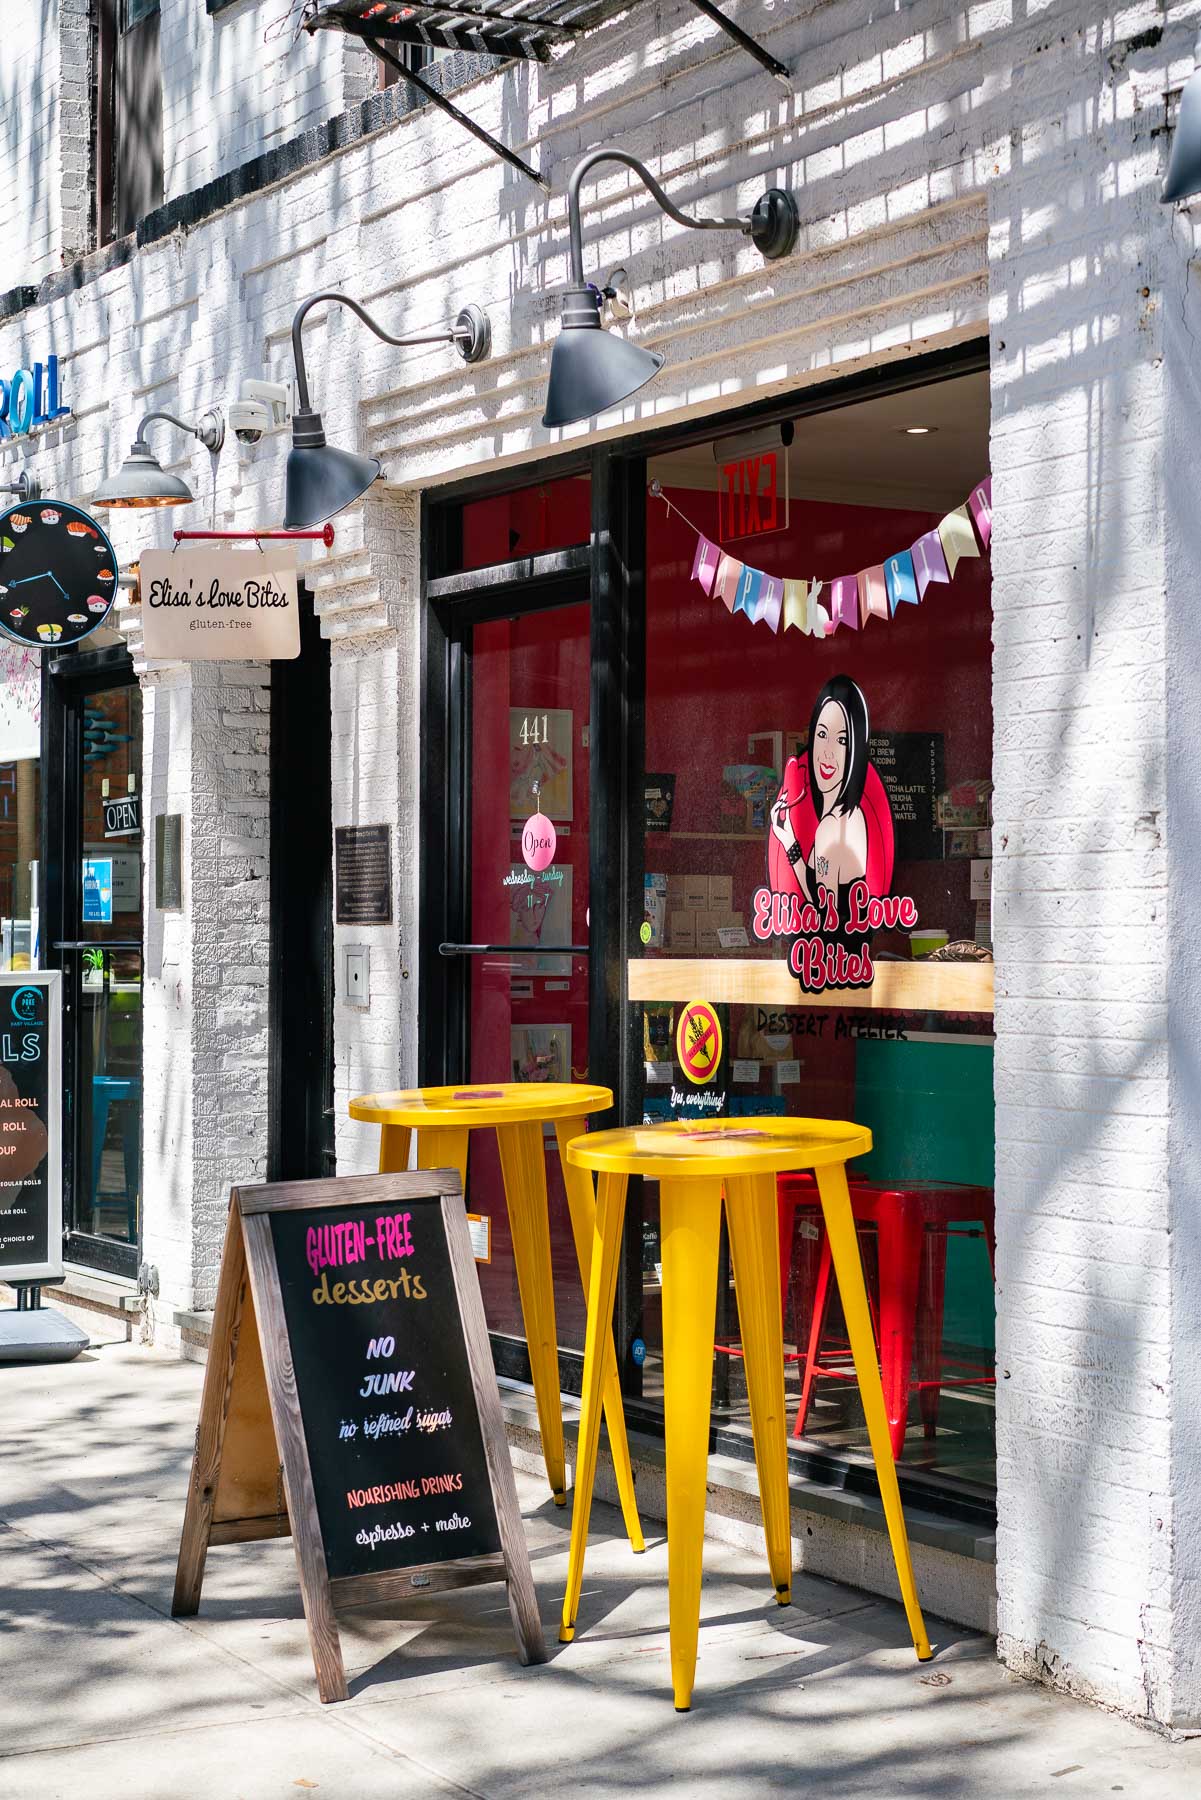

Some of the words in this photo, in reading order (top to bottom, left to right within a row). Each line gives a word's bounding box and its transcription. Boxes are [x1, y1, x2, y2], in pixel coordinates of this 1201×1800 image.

[150, 578, 205, 608] Elisa's
[244, 580, 289, 608] Bites
[189, 619, 252, 630] gluten-free
[519, 714, 549, 745] 441
[877, 748, 895, 756] BREW
[930, 749, 935, 757] 5
[930, 758, 935, 766] 5
[930, 767, 935, 775] 5
[905, 785, 926, 793] LATTE
[106, 803, 138, 831] OPEN
[524, 831, 553, 857] Open
[503, 869, 535, 889] wednesday
[753, 885, 839, 940] Elisa's
[845, 880, 918, 934] Love
[790, 937, 874, 989] Bites
[757, 1007, 829, 1039] DESSERT
[15, 1098, 38, 1107] ROLL
[3, 1122, 26, 1131] ROLL
[306, 1212, 415, 1276] GLUTEN-FREE
[312, 1267, 427, 1304] desserts
[366, 1336, 395, 1360] NO
[360, 1370, 416, 1397] JUNK
[338, 1423, 359, 1439] no
[363, 1406, 413, 1439] refined
[416, 1408, 453, 1433] sugar
[346, 1480, 420, 1509] NOURISHING
[421, 1473, 463, 1496] DRINKS
[356, 1521, 415, 1550] espresso
[420, 1522, 430, 1533] +
[435, 1512, 471, 1533] more
